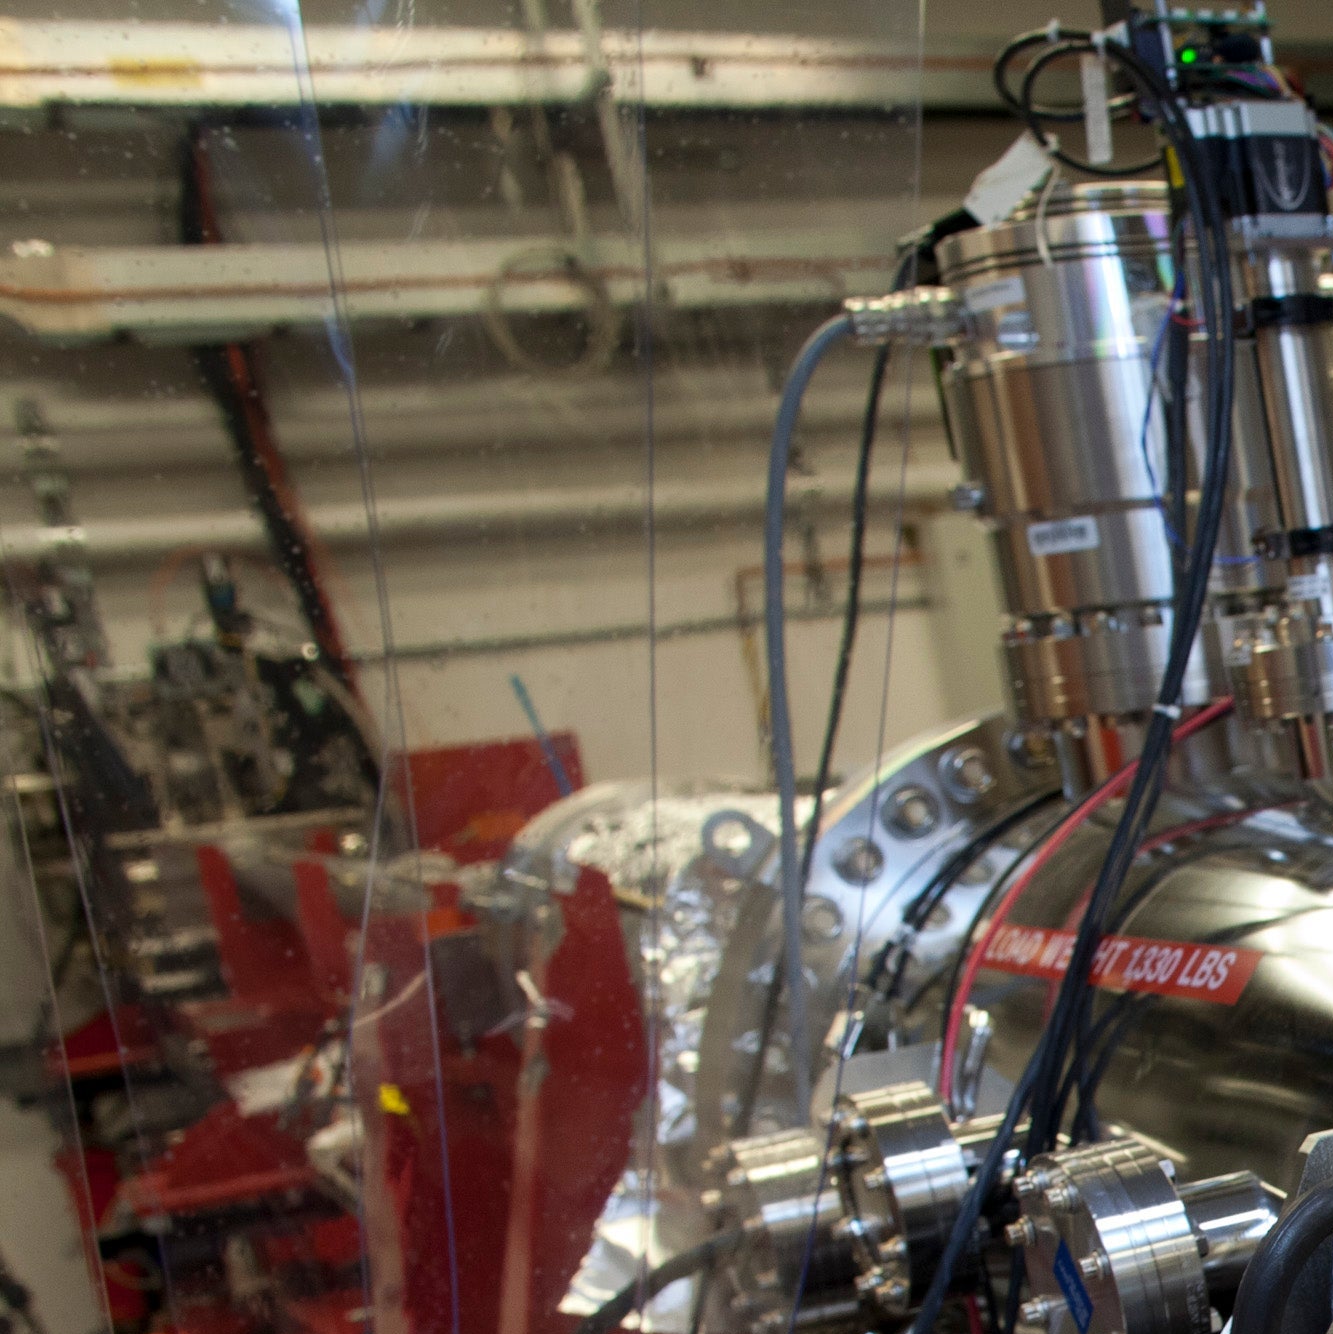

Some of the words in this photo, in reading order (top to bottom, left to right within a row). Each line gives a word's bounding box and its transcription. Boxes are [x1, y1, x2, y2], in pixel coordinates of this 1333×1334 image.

[985, 925, 1045, 966] LOAD
[1040, 932, 1130, 978] WEHT
[1176, 948, 1238, 991] LBS
